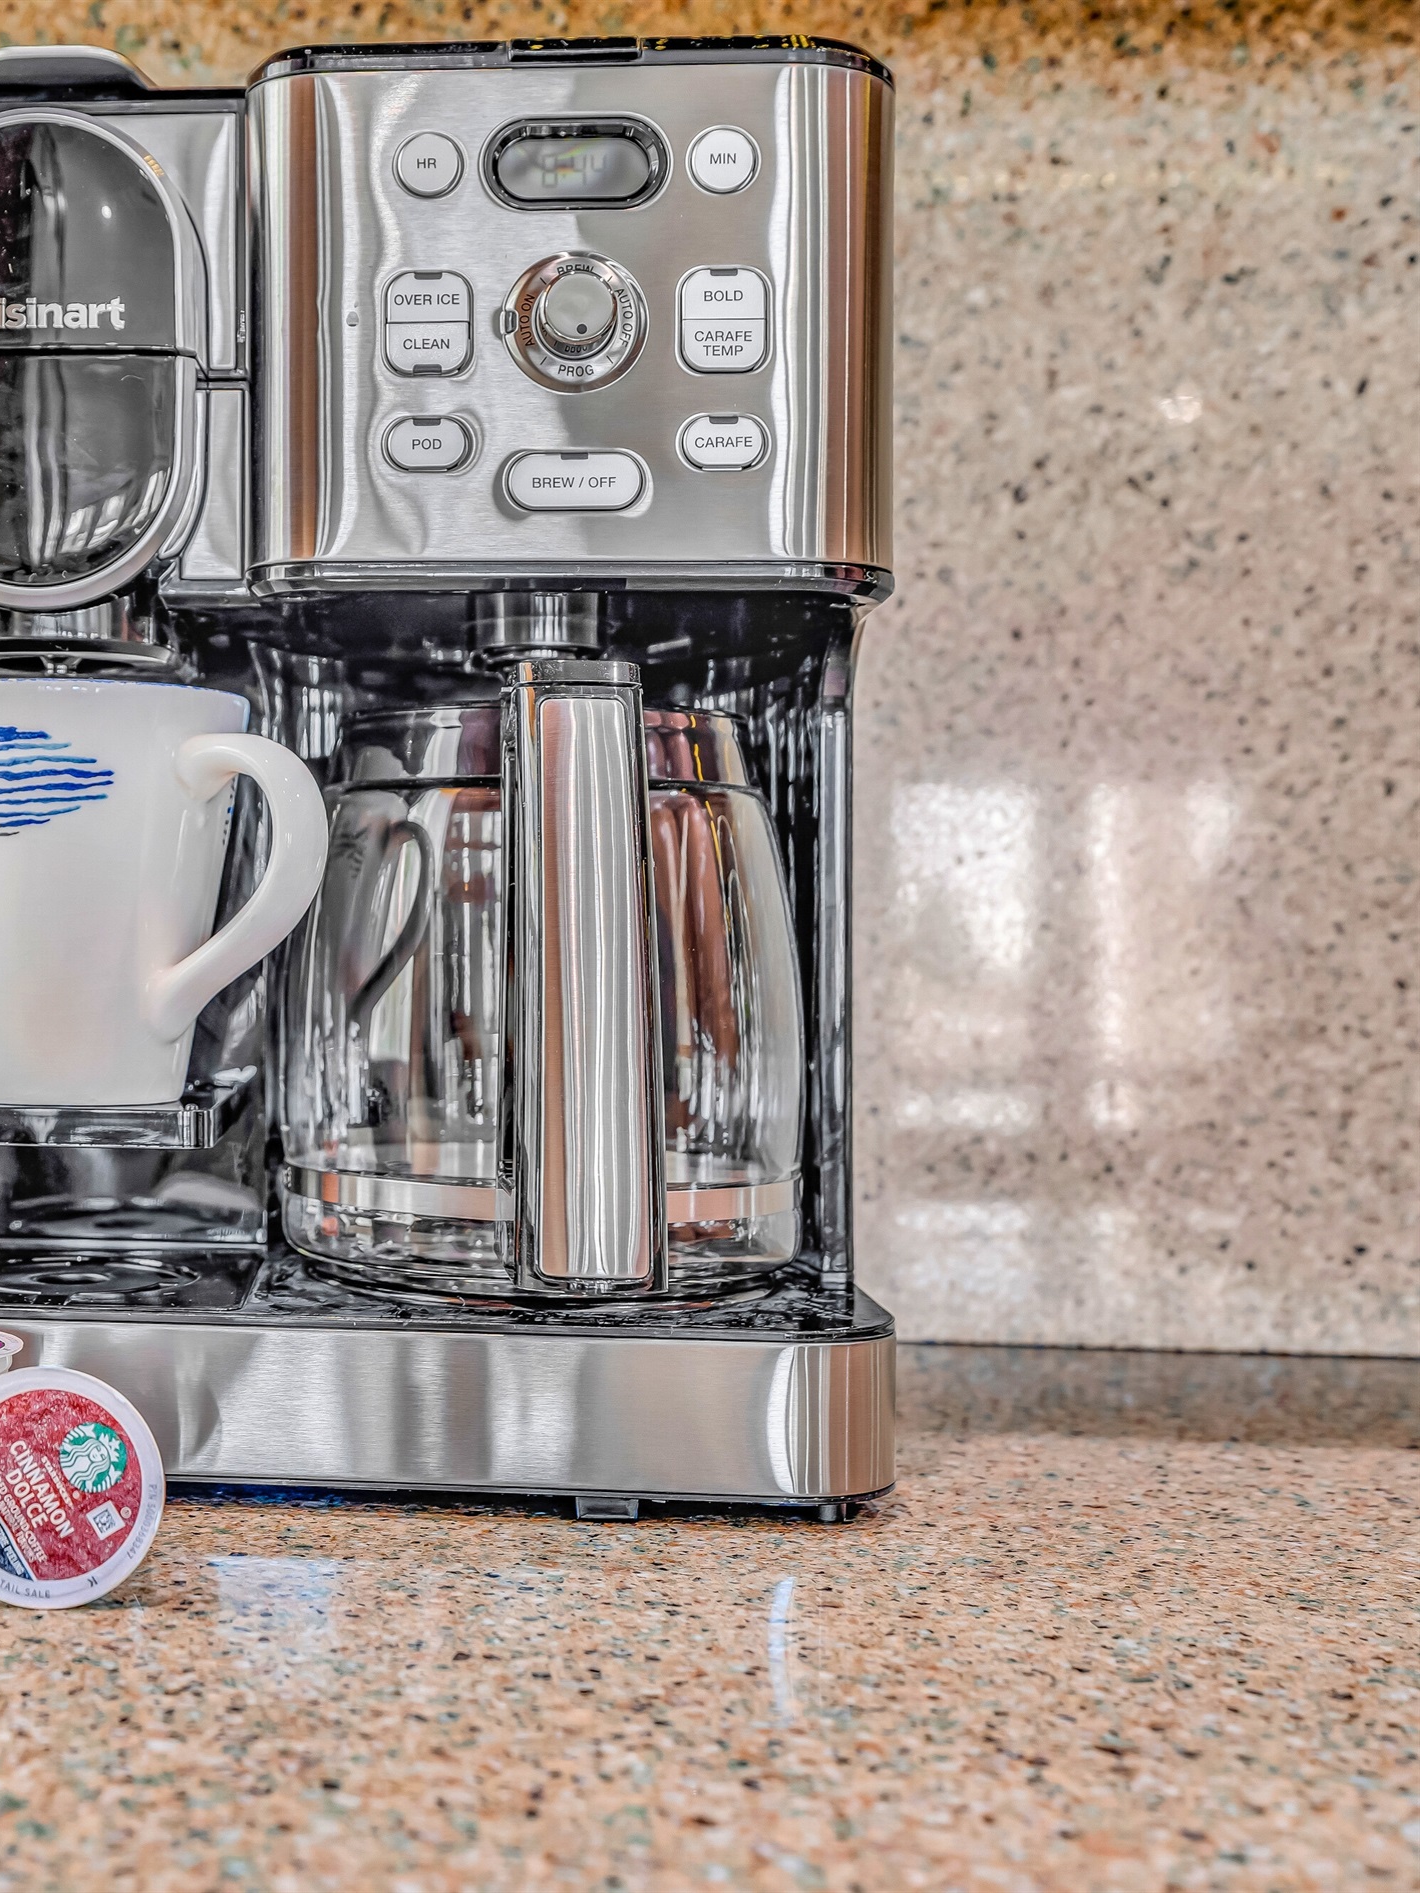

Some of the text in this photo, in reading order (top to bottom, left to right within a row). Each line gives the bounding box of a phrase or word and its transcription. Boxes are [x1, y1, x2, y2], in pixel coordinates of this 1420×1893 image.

[416, 157, 437, 170] HR
[709, 152, 737, 165] MIN
[393, 293, 460, 306] OVER ICE
[704, 289, 743, 301] BOLD
[520, 294, 535, 347] AUTO ON
[614, 288, 633, 348] AUTO OFF
[403, 337, 450, 350] CLEAN
[694, 330, 753, 344] CARAFE
[703, 344, 744, 357] TEMP
[558, 364, 594, 377] PROG
[411, 438, 442, 450] POD
[694, 436, 753, 448] CARAFE
[532, 477, 574, 489] BREW
[588, 476, 617, 488] OFF
[10, 1440, 74, 1539] CINNAMON
[6, 1469, 48, 1528] DOLCE
[4, 1494, 29, 1532] GROUND
[25, 1529, 48, 1563] COFFEE
[24, 1587, 51, 1599] SALE
